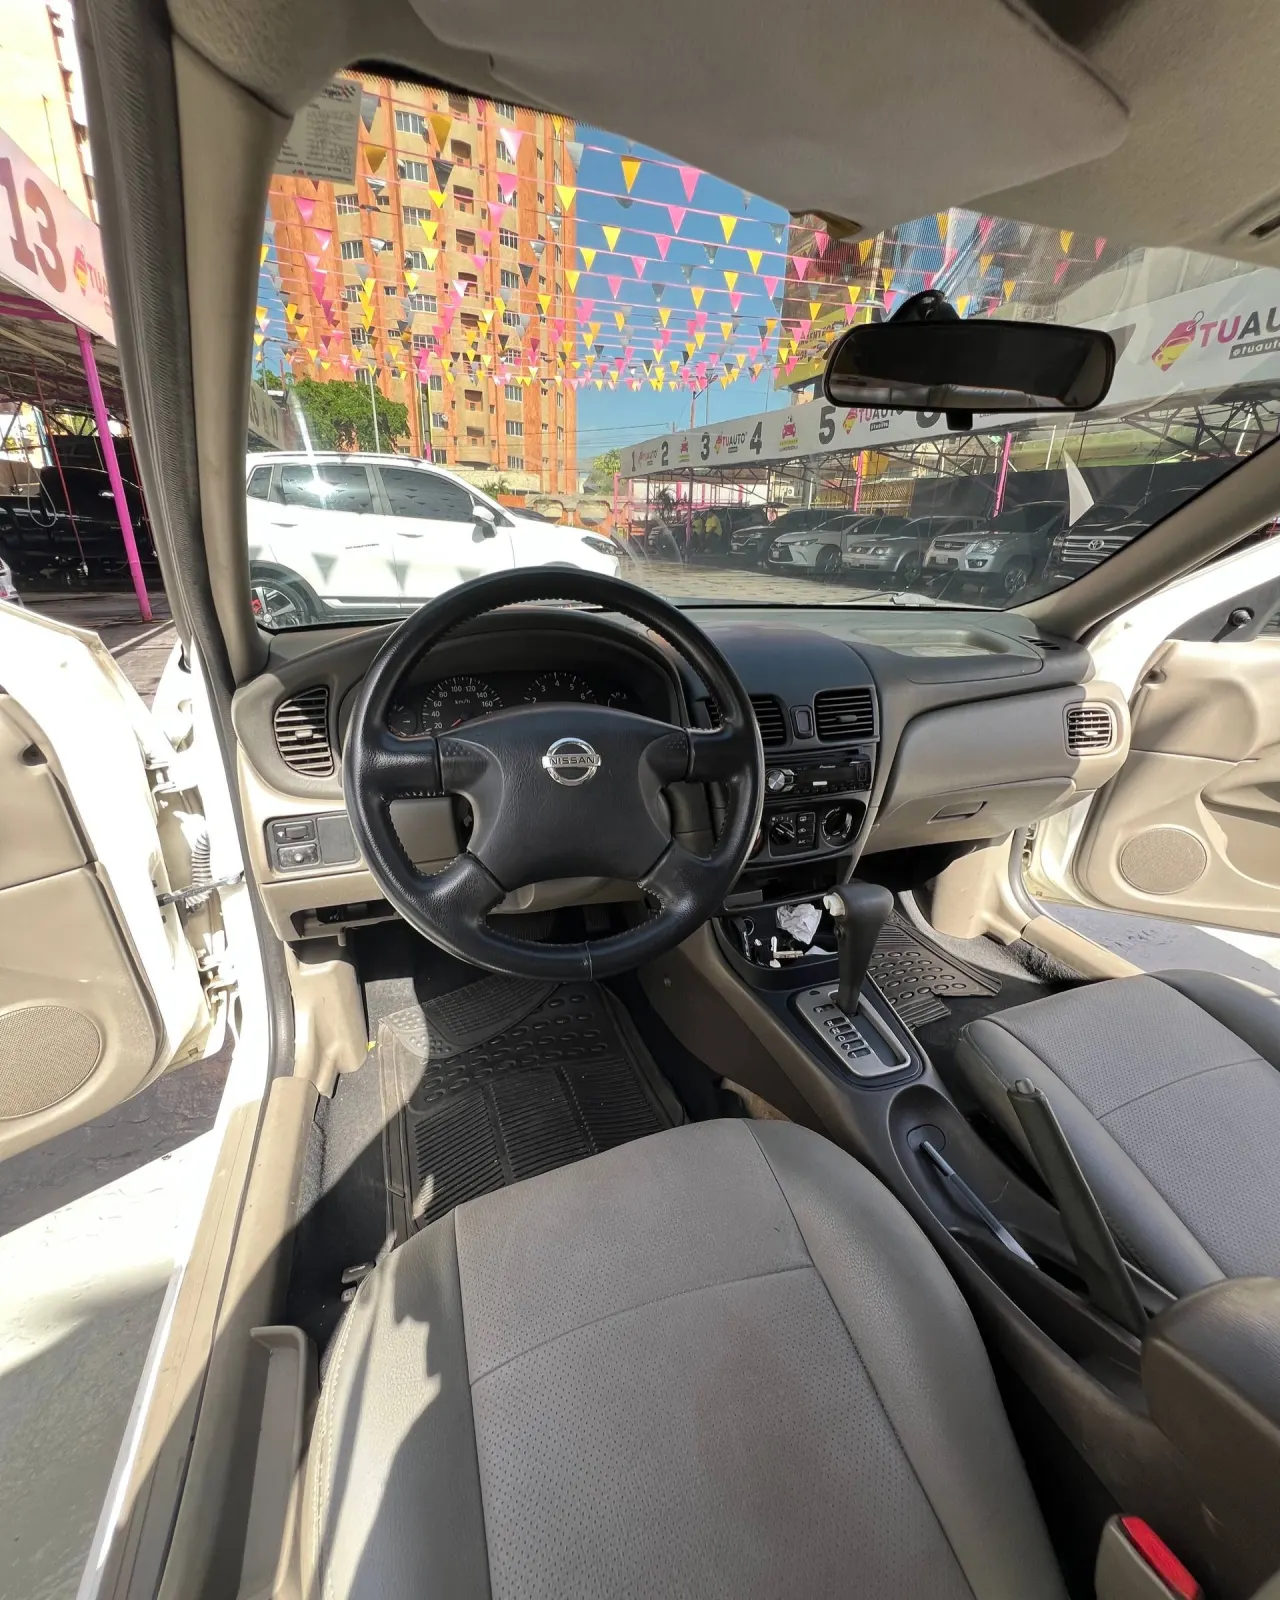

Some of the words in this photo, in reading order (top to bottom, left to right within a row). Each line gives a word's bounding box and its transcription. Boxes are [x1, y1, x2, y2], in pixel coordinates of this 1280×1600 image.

[0, 156, 67, 293] 13
[661, 441, 669, 466] 2
[700, 432, 710, 460] 3
[749, 421, 763, 455] 4
[818, 405, 836, 445] 5
[551, 756, 595, 765] NISSAN
